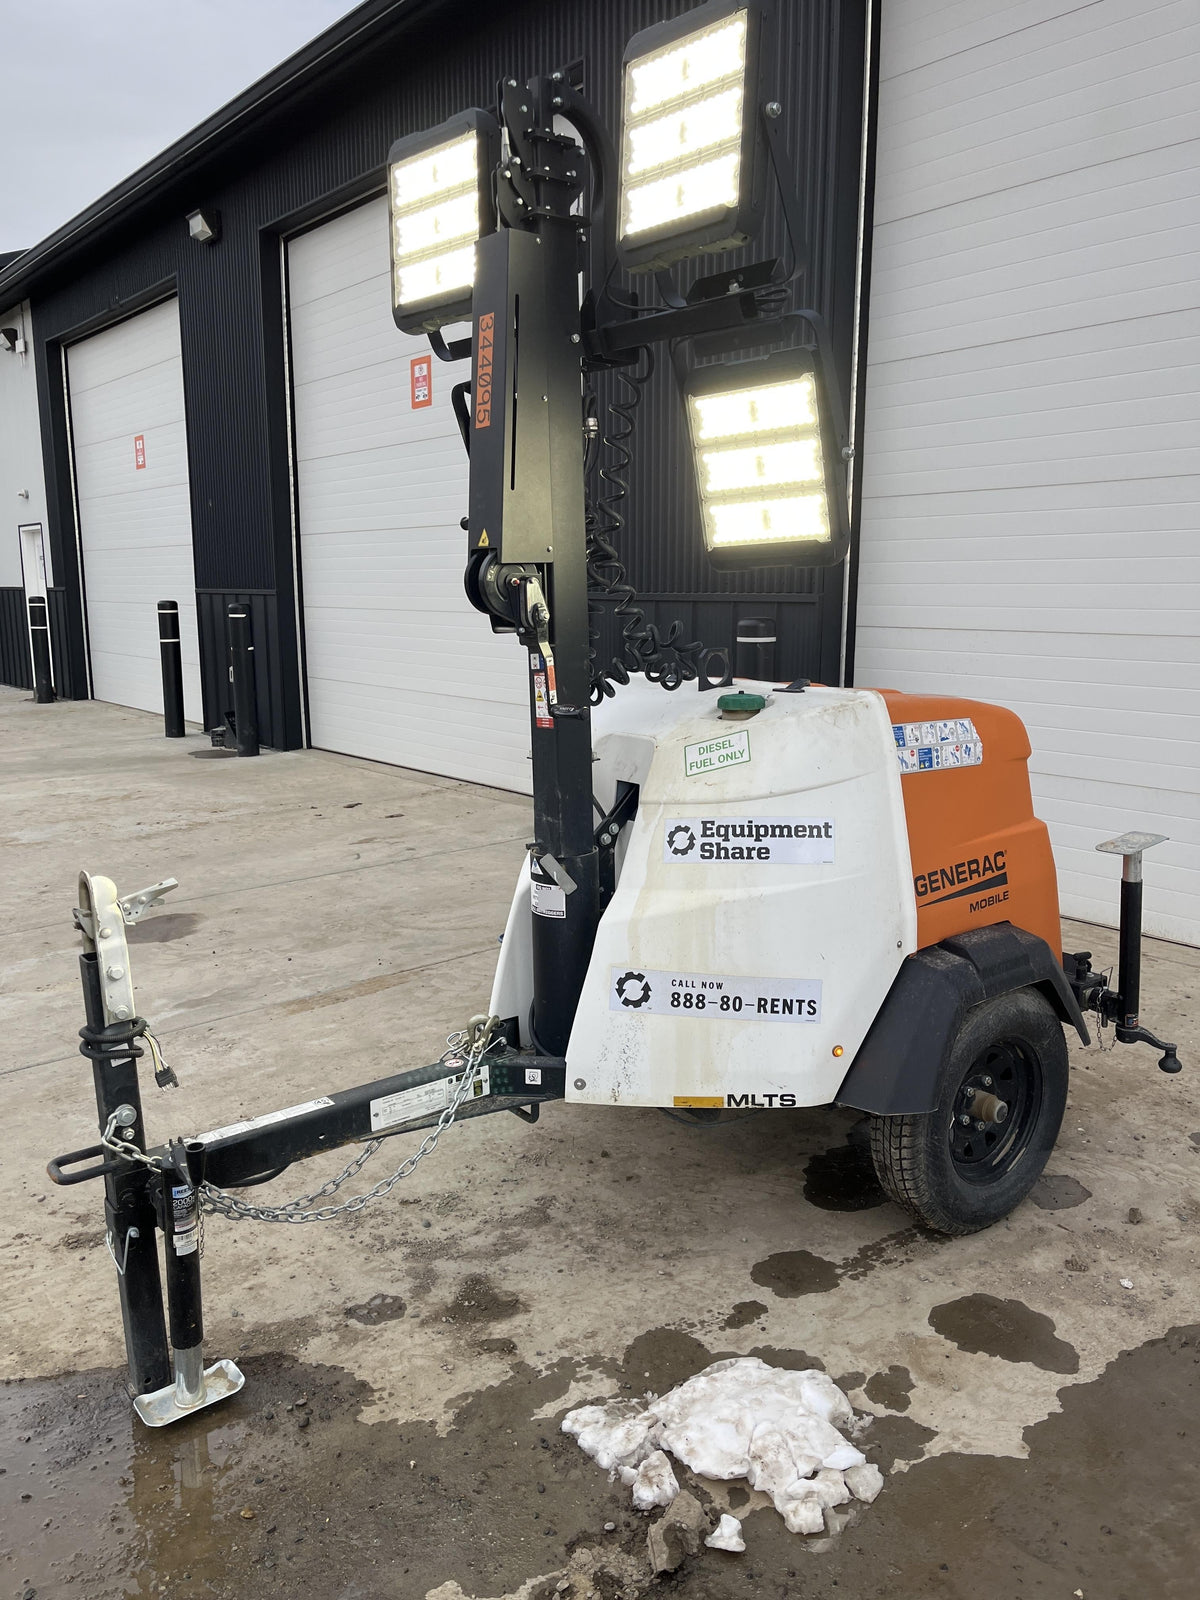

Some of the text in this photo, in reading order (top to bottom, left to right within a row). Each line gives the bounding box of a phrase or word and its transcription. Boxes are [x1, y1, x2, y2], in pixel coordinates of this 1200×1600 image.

[477, 316, 493, 424] 344095
[698, 739, 735, 756] DIESEL
[689, 748, 745, 771] FUEL ONLY
[700, 820, 833, 842] Equipment
[700, 842, 770, 860] Share
[914, 850, 1006, 897] GENERAC
[969, 890, 1010, 913] MOBILE
[671, 979, 724, 990] CALL NOW
[670, 991, 818, 1016] 888-80-RENTS
[727, 1093, 797, 1107] MLTS
